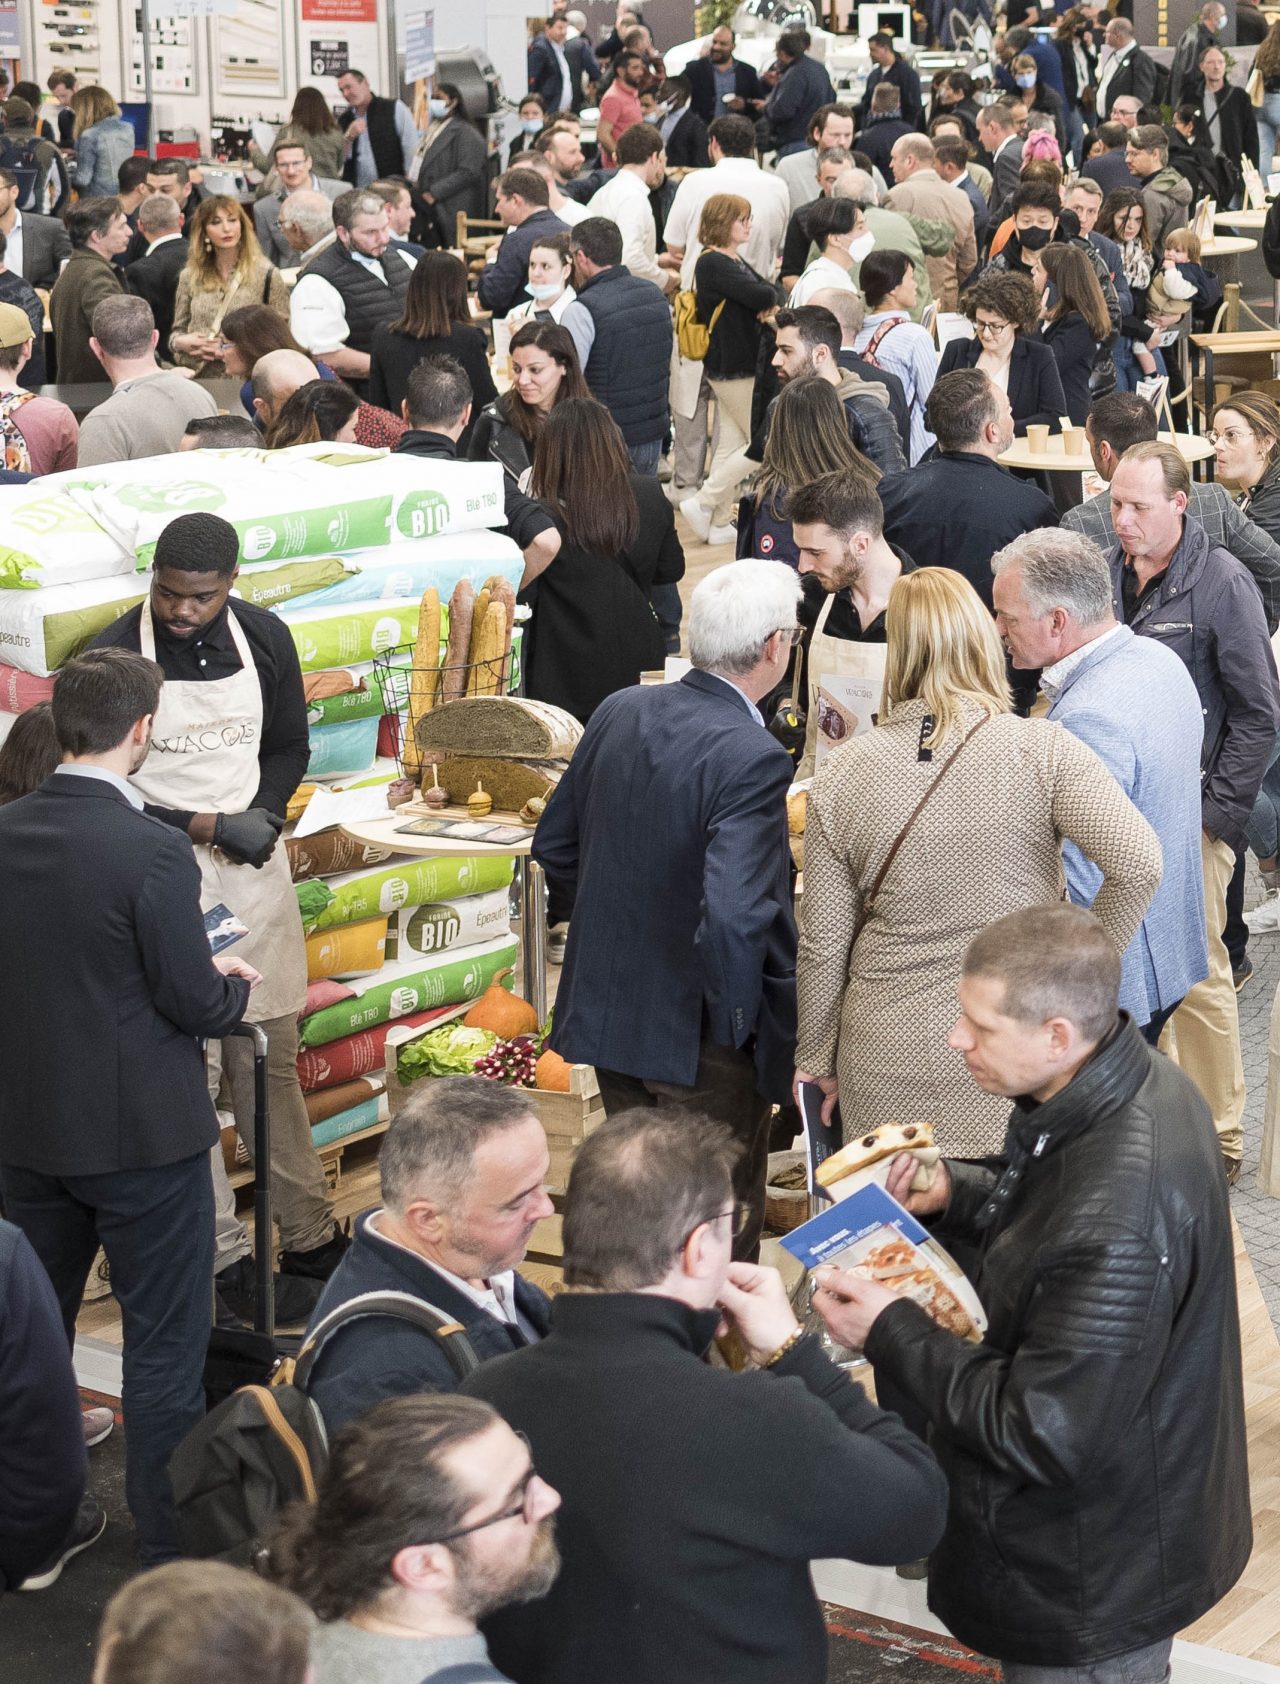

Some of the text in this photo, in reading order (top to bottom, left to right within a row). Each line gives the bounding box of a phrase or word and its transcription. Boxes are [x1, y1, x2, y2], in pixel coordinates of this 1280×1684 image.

[411, 503, 449, 537] BIO
[255, 528, 271, 550] BIO
[252, 582, 292, 602] Épeautre
[390, 878, 405, 903] BIO
[428, 910, 451, 921] FARINE
[476, 907, 509, 928] Épeautr
[421, 919, 459, 952] BIO
[401, 988, 415, 1011] BIO
[350, 1006, 379, 1027] Blé T80
[809, 1228, 851, 1255] Avec vous
